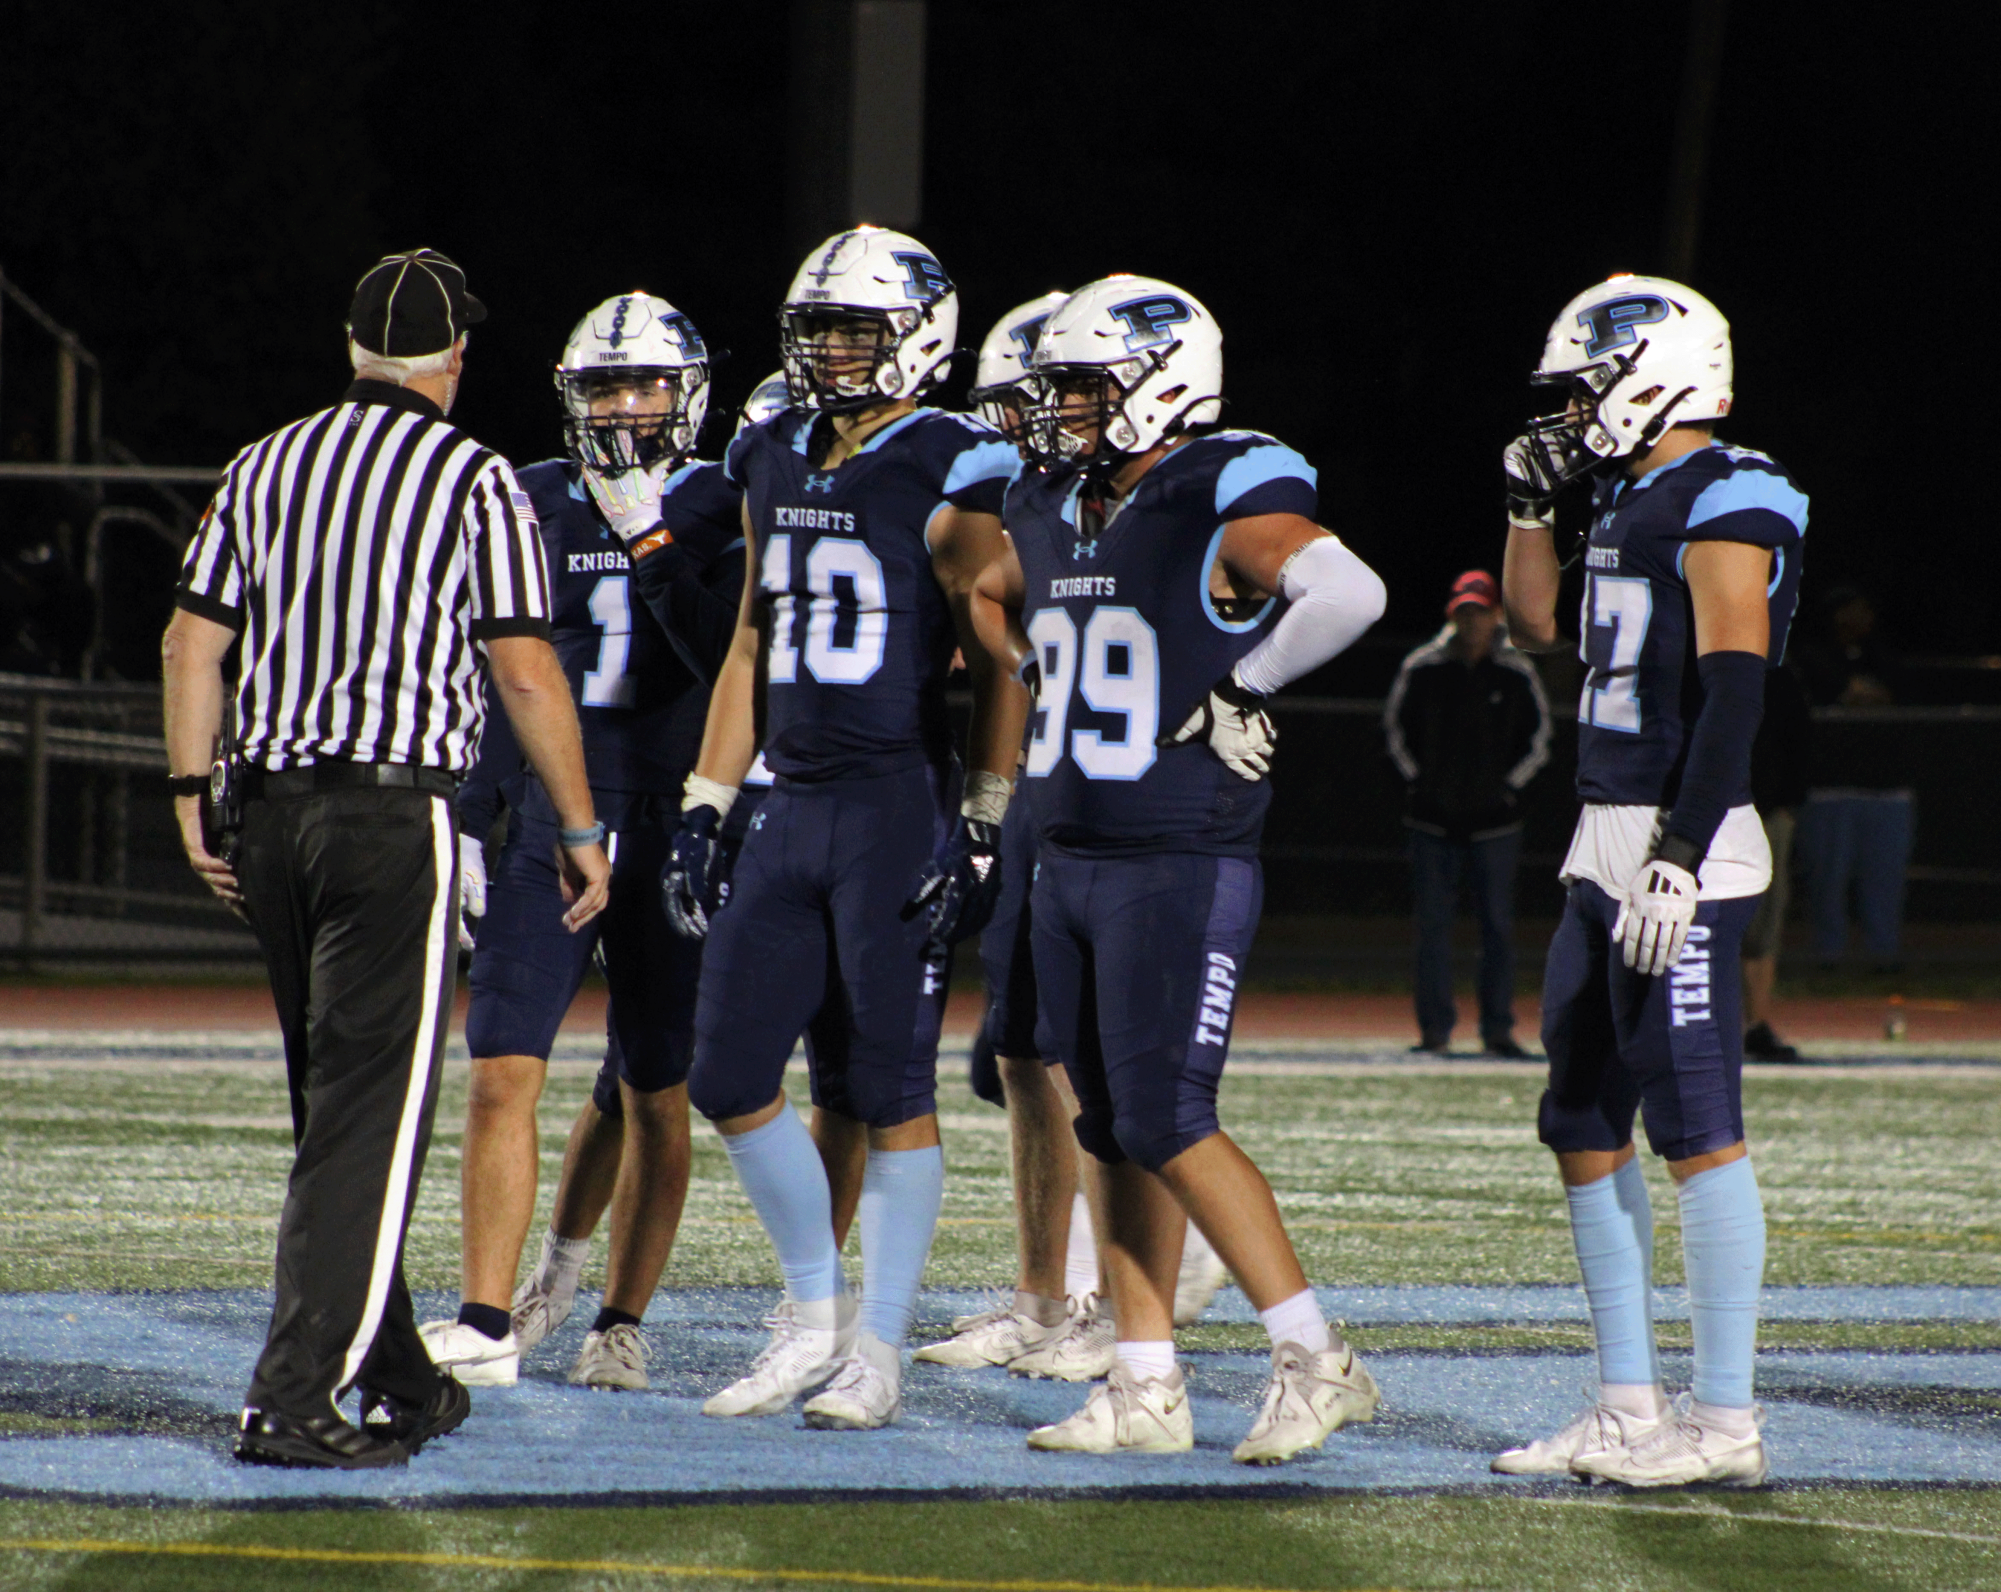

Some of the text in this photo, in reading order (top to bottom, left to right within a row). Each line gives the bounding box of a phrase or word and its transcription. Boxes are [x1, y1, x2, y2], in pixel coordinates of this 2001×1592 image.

[1108, 294, 1192, 353] P
[1577, 294, 1669, 359] P
[599, 352, 628, 362] TEMPO
[775, 507, 855, 532] KNIGHTS
[760, 533, 889, 685] 10
[1050, 576, 1116, 599] KNIGHTS
[582, 575, 638, 709] 1
[1026, 604, 1161, 782] 99
[1195, 951, 1236, 1047] TEMPO
